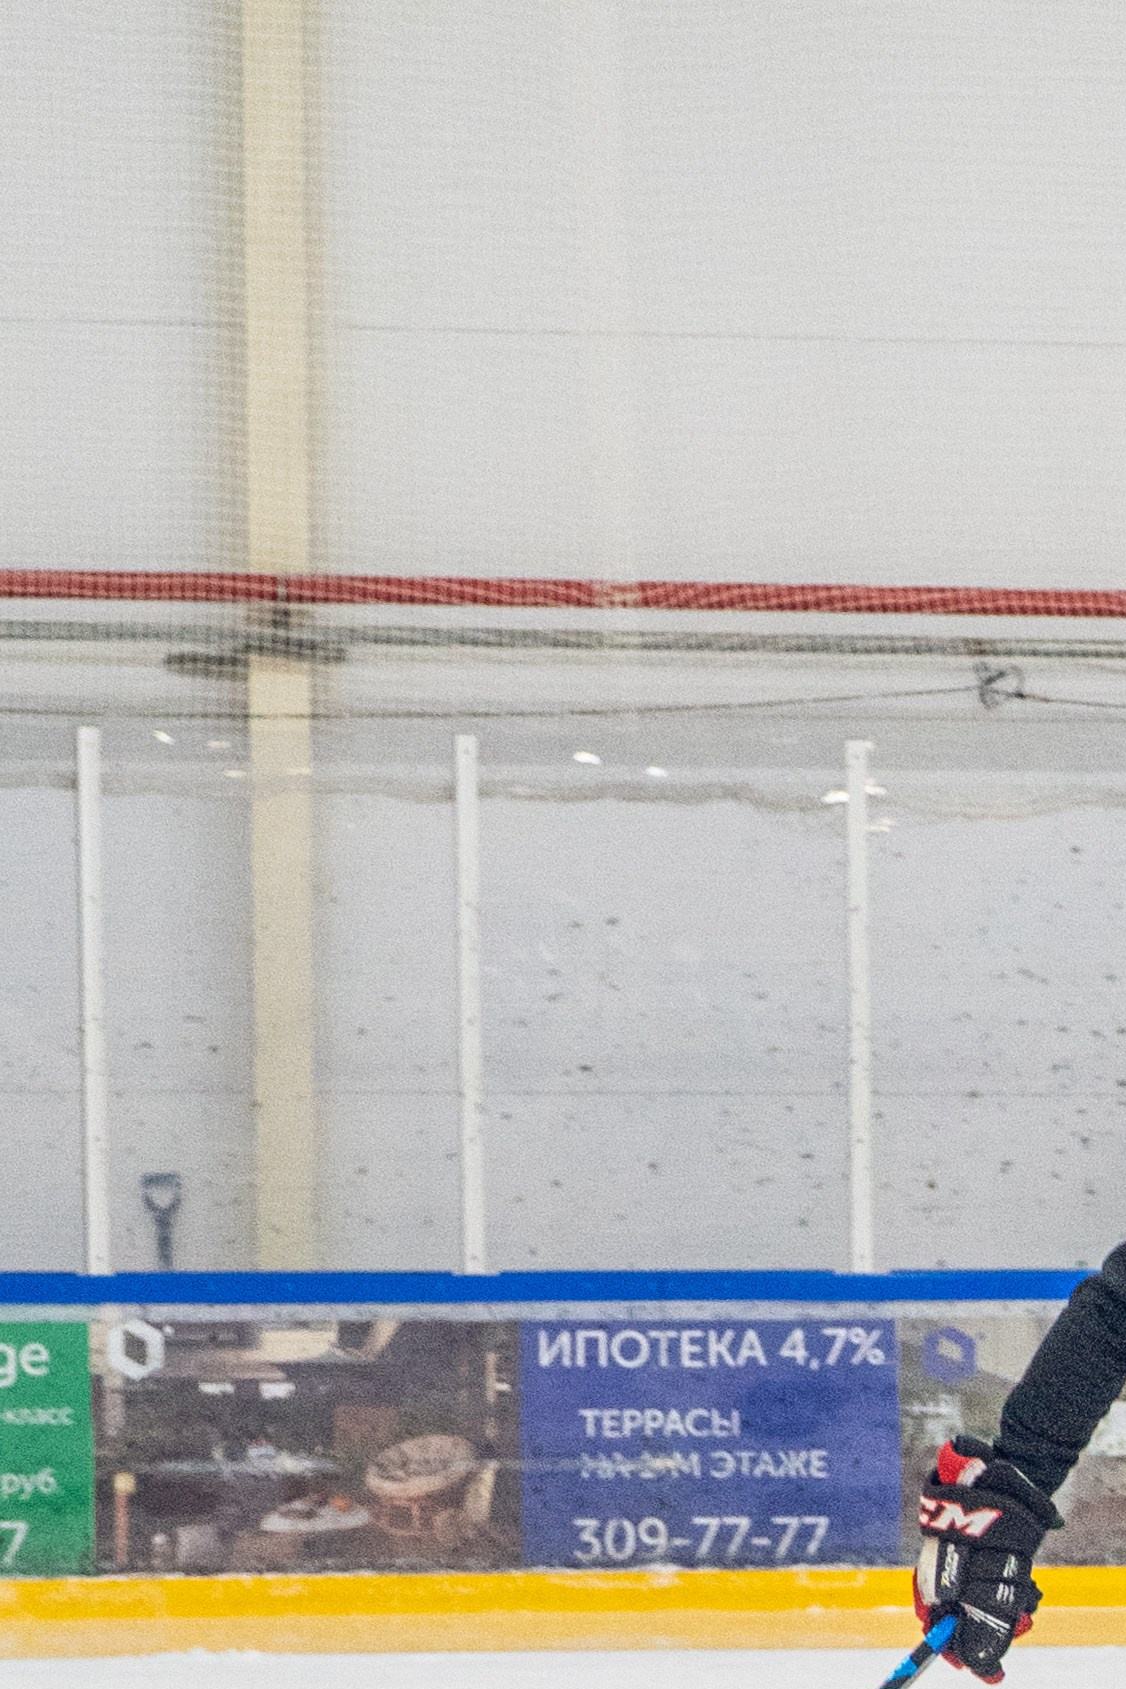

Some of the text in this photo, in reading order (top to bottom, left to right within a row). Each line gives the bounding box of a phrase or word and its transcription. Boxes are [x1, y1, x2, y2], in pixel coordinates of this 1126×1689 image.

[537, 1327, 886, 1371] ИПОТЕКА 4,7%
[578, 1408, 741, 1438] ТЕРРАСЫ
[709, 1450, 829, 1480] ЭТАЖЕ
[572, 1515, 830, 1561] 309-77-77
